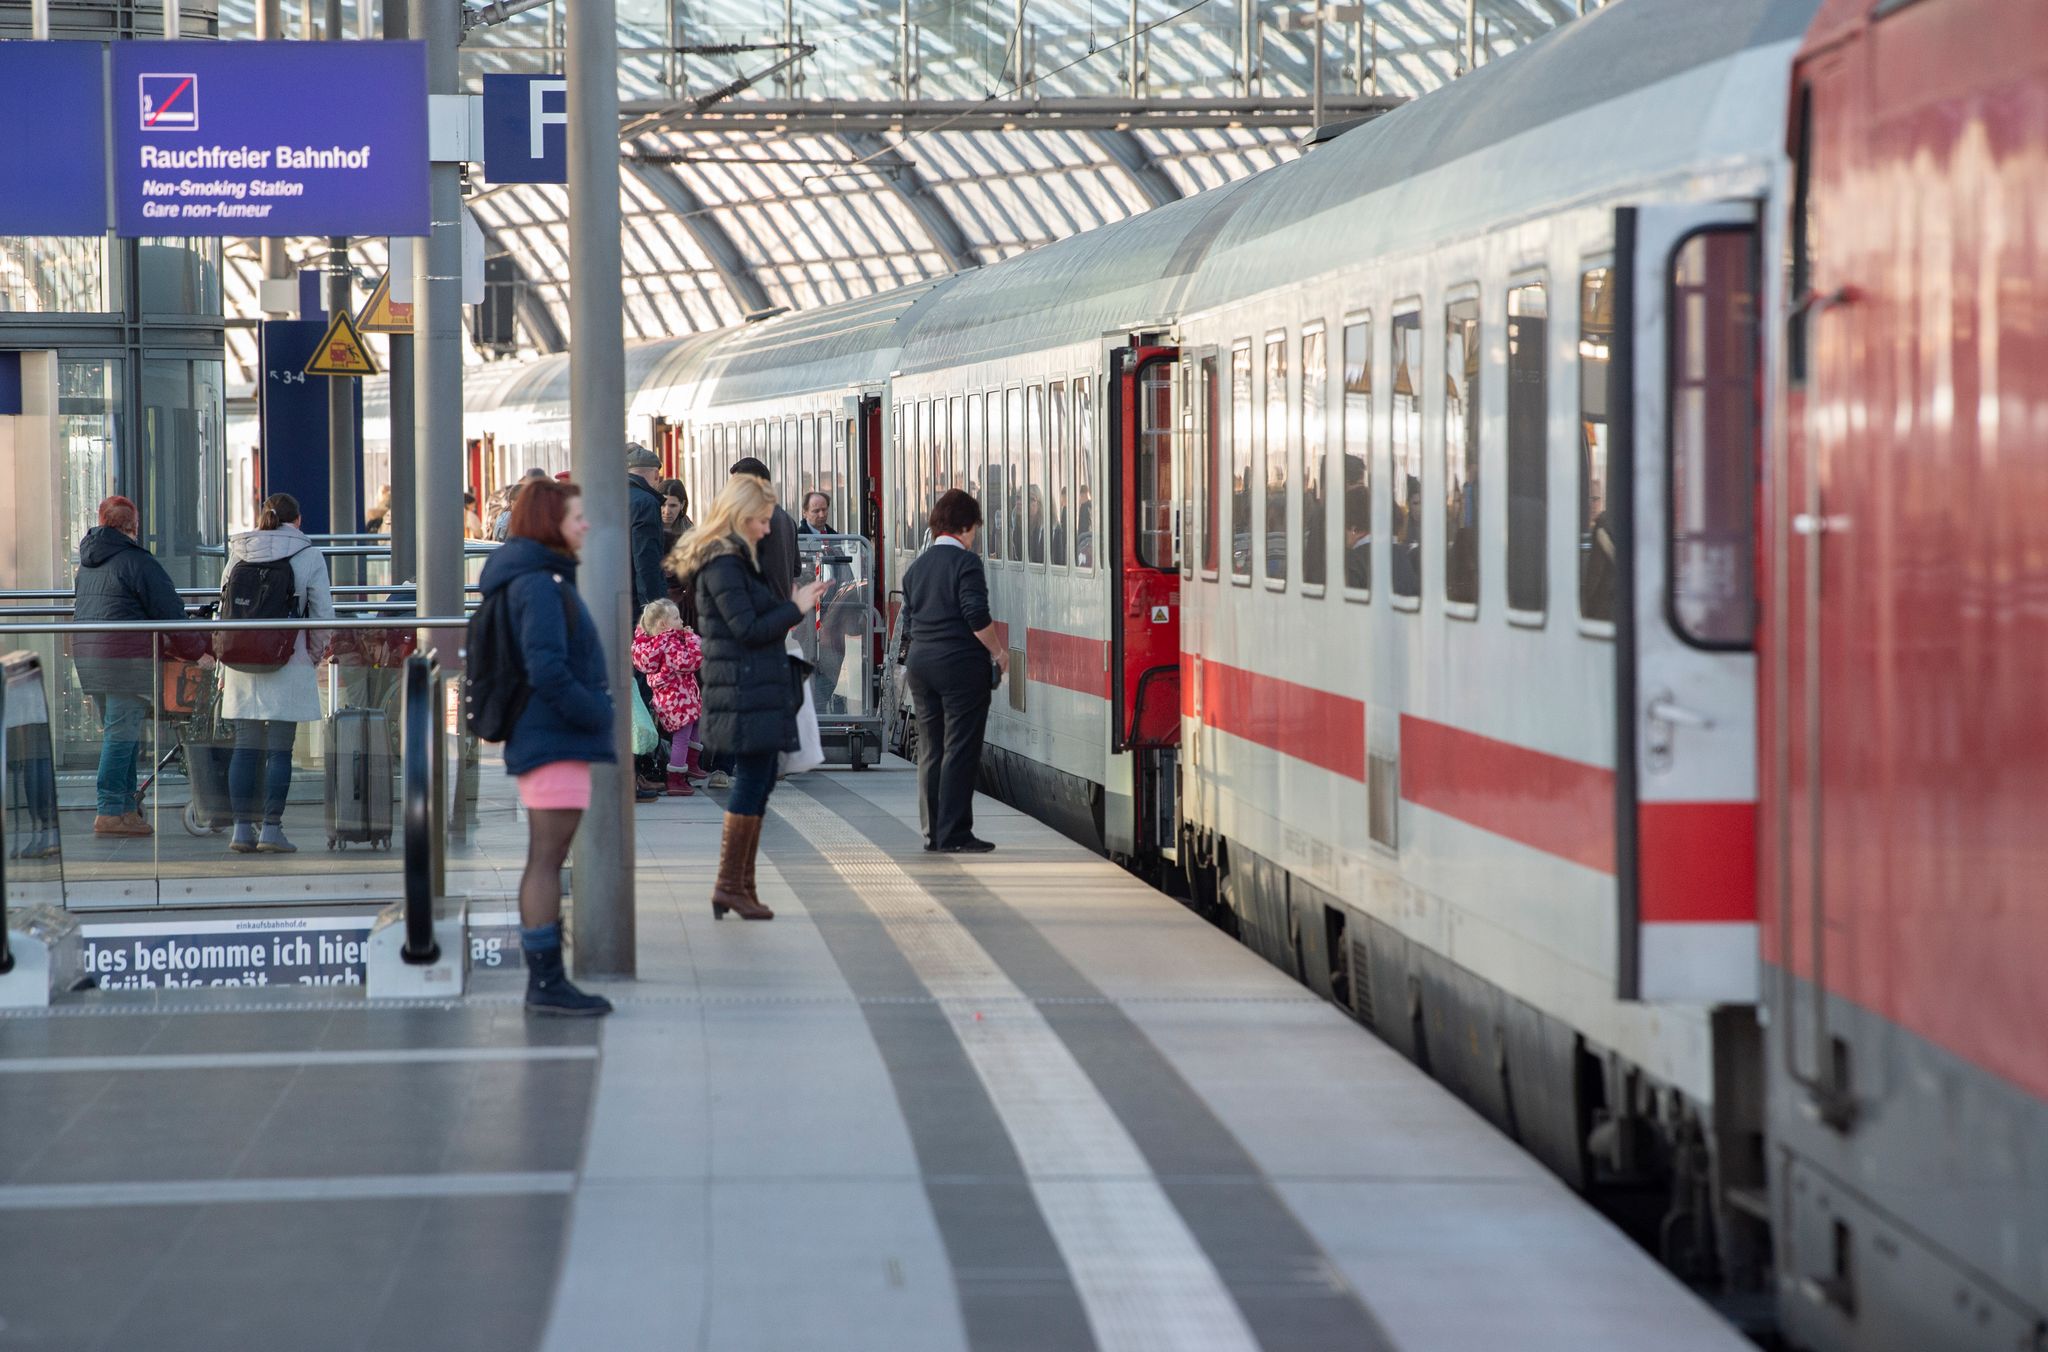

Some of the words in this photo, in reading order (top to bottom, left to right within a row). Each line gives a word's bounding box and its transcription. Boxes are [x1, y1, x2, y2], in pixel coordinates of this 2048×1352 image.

[529, 80, 568, 159] F
[140, 145, 271, 168] Rauchfreier
[275, 145, 371, 168] Bahnhof
[142, 179, 247, 199] Non-Smoking
[249, 179, 304, 197] Station
[142, 201, 180, 218] Gare
[182, 201, 272, 218] non-fumeur
[283, 370, 305, 384] 3-4
[236, 919, 307, 930] einkaufsbahnhof.de
[134, 940, 266, 972] bekomme
[273, 936, 313, 967] ich
[318, 934, 368, 965] hier
[467, 931, 502, 967] ag
